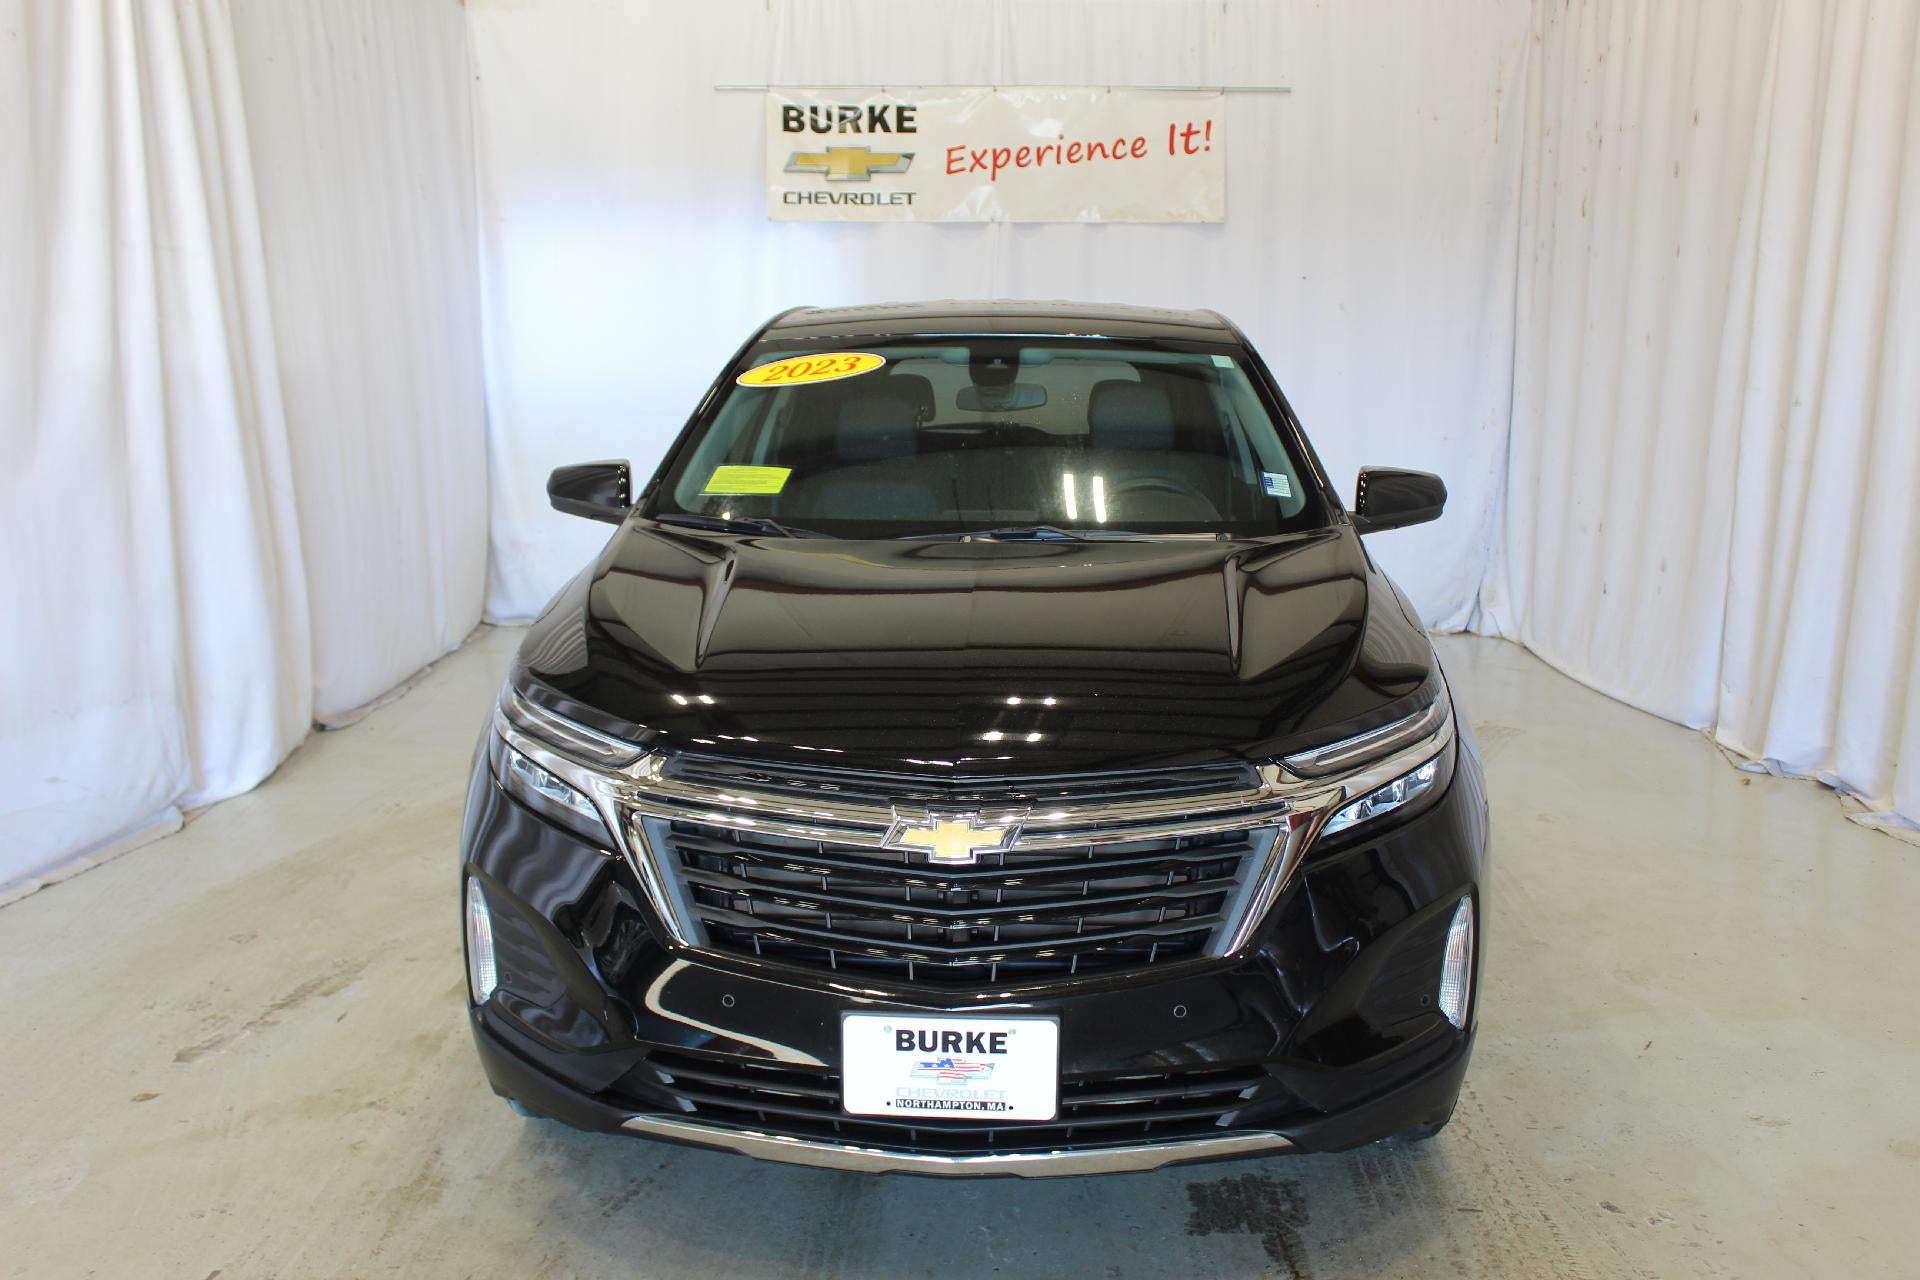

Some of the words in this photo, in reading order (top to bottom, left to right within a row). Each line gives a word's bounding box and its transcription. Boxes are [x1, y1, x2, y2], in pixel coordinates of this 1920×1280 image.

[782, 105, 917, 134] BURKE
[945, 133, 1148, 180] Experience
[1168, 120, 1213, 155] It!
[783, 191, 917, 206] CHEVROLET
[762, 357, 861, 382] 2023
[895, 1029, 1008, 1054] BURKE
[896, 1087, 1008, 1100] CHEVROLET
[987, 1102, 1005, 1111] MA
